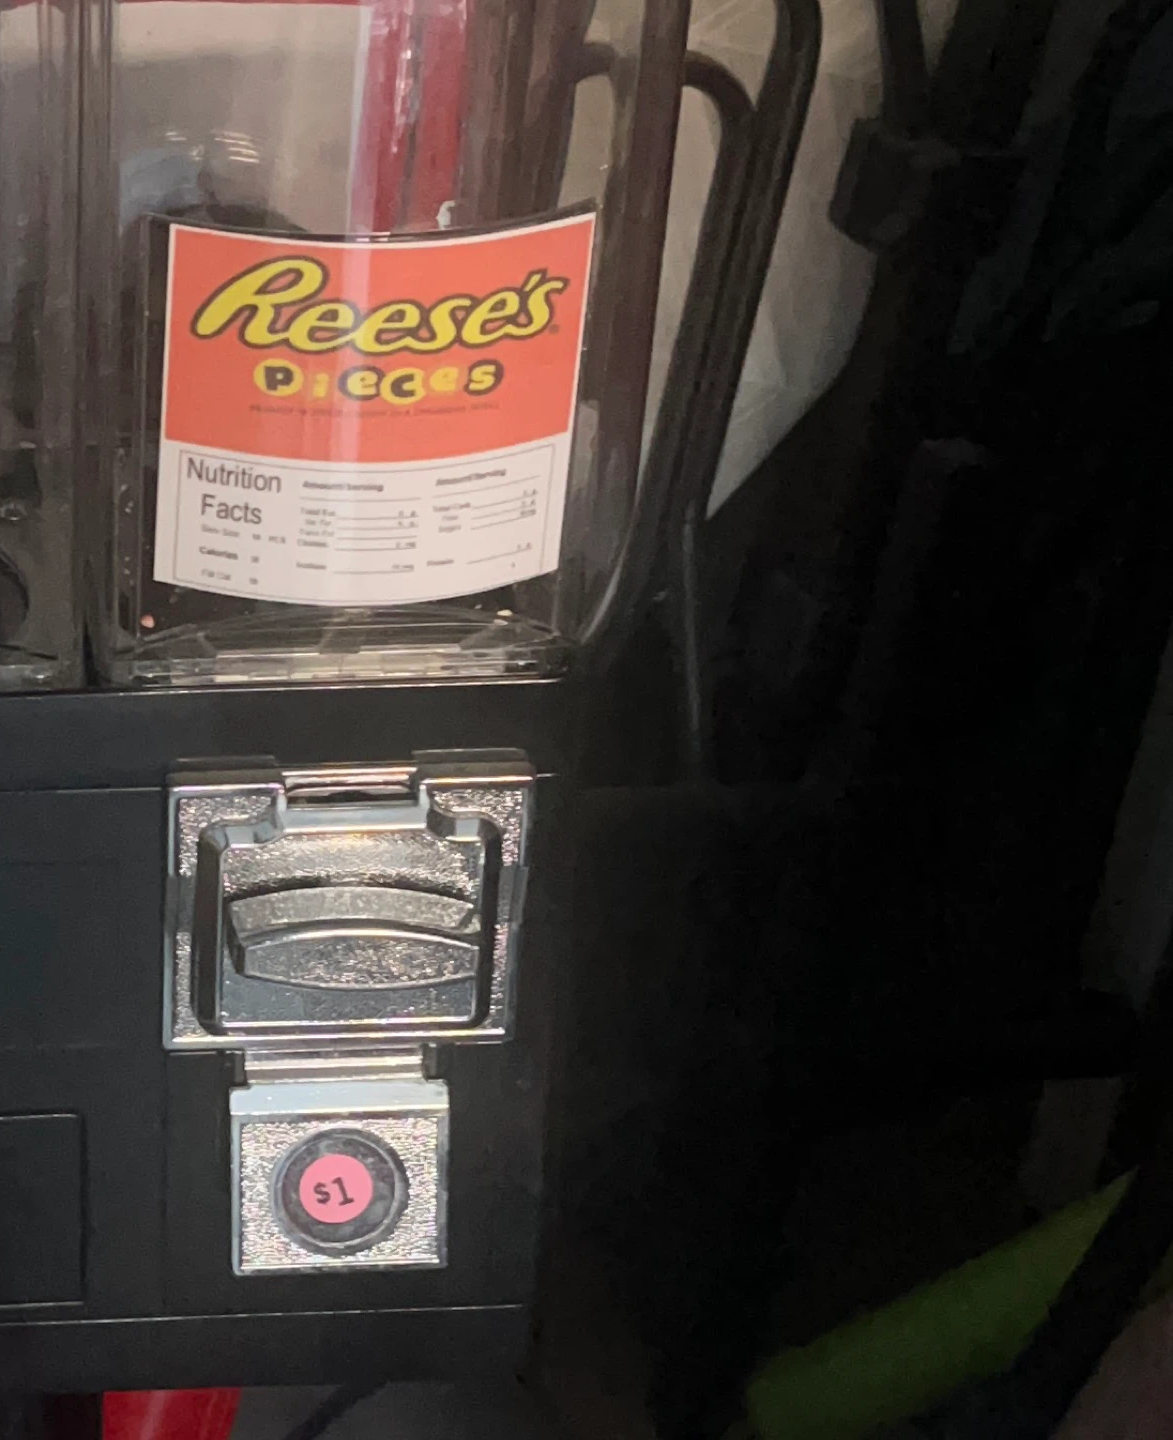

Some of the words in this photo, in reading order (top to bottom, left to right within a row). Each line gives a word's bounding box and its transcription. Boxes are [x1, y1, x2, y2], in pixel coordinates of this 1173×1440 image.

[190, 255, 569, 356] Reese's
[186, 457, 282, 494] Nutrition
[200, 492, 263, 525] Facts
[313, 1176, 355, 1206] $1
